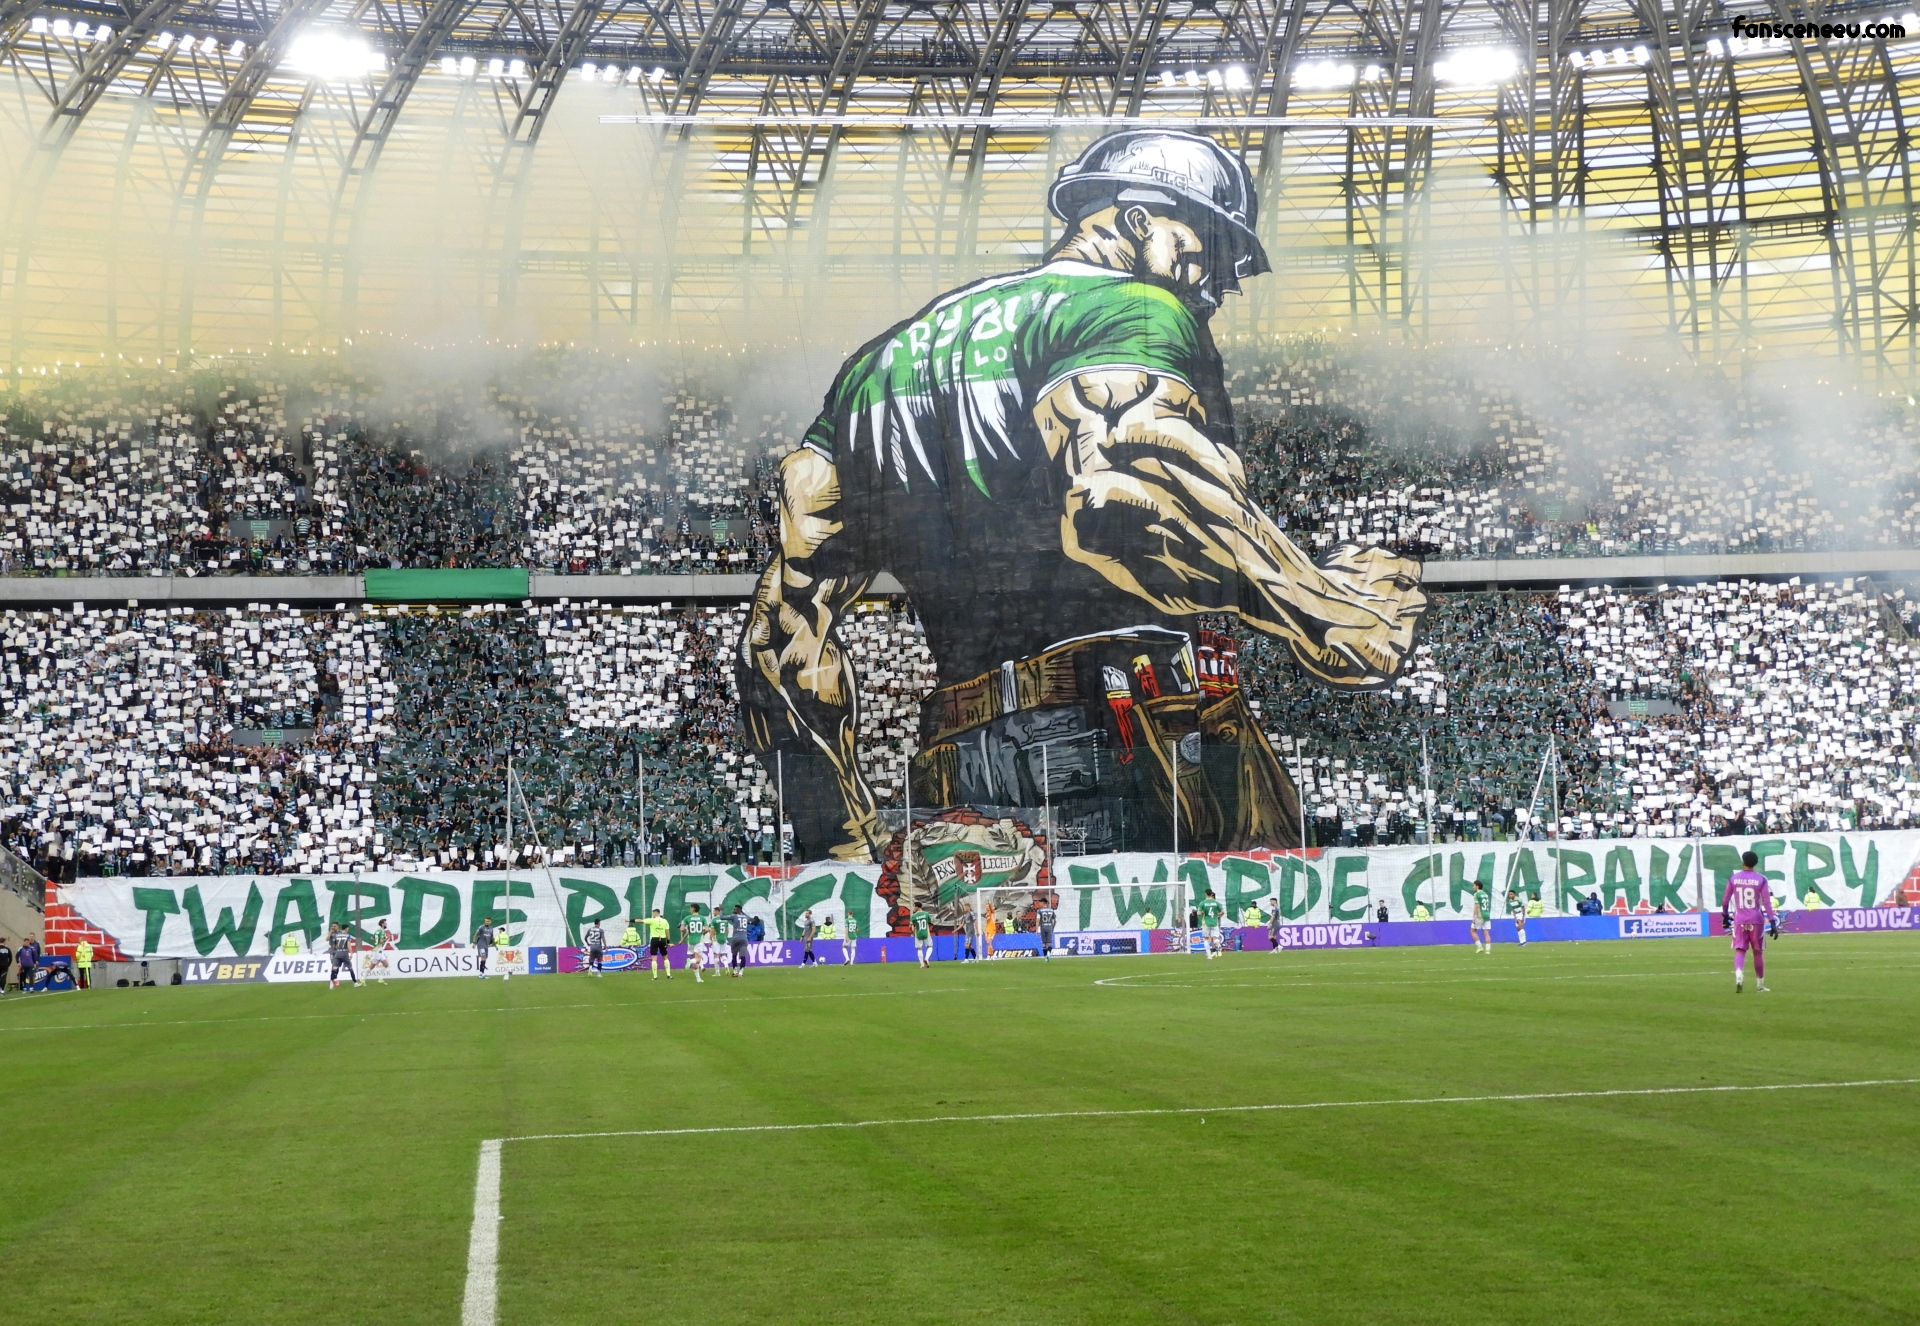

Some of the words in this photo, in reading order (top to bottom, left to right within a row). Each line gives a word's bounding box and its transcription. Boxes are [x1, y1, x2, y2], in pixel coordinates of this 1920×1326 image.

[934, 860, 957, 880] BKS
[982, 857, 1018, 870] LECHIA
[1733, 879, 1759, 887] PAULSEN
[132, 877, 535, 957] TWARDE
[1068, 856, 1370, 931] TWARDE
[1401, 836, 1880, 916] CHARAKTERY
[1736, 887, 1756, 909] 18
[1042, 912, 1053, 923] 67
[1208, 906, 1215, 918] 4
[1832, 907, 1912, 929] SŁODYCZ
[689, 921, 703, 933] 80
[720, 922, 726, 934] 5
[738, 918, 748, 929] 18
[916, 919, 927, 931] 10
[589, 931, 600, 942] 22
[1279, 924, 1363, 946] SŁODYCZ
[335, 937, 348, 949] 77
[186, 962, 262, 981] LVBET
[273, 960, 351, 975] LVBET.L
